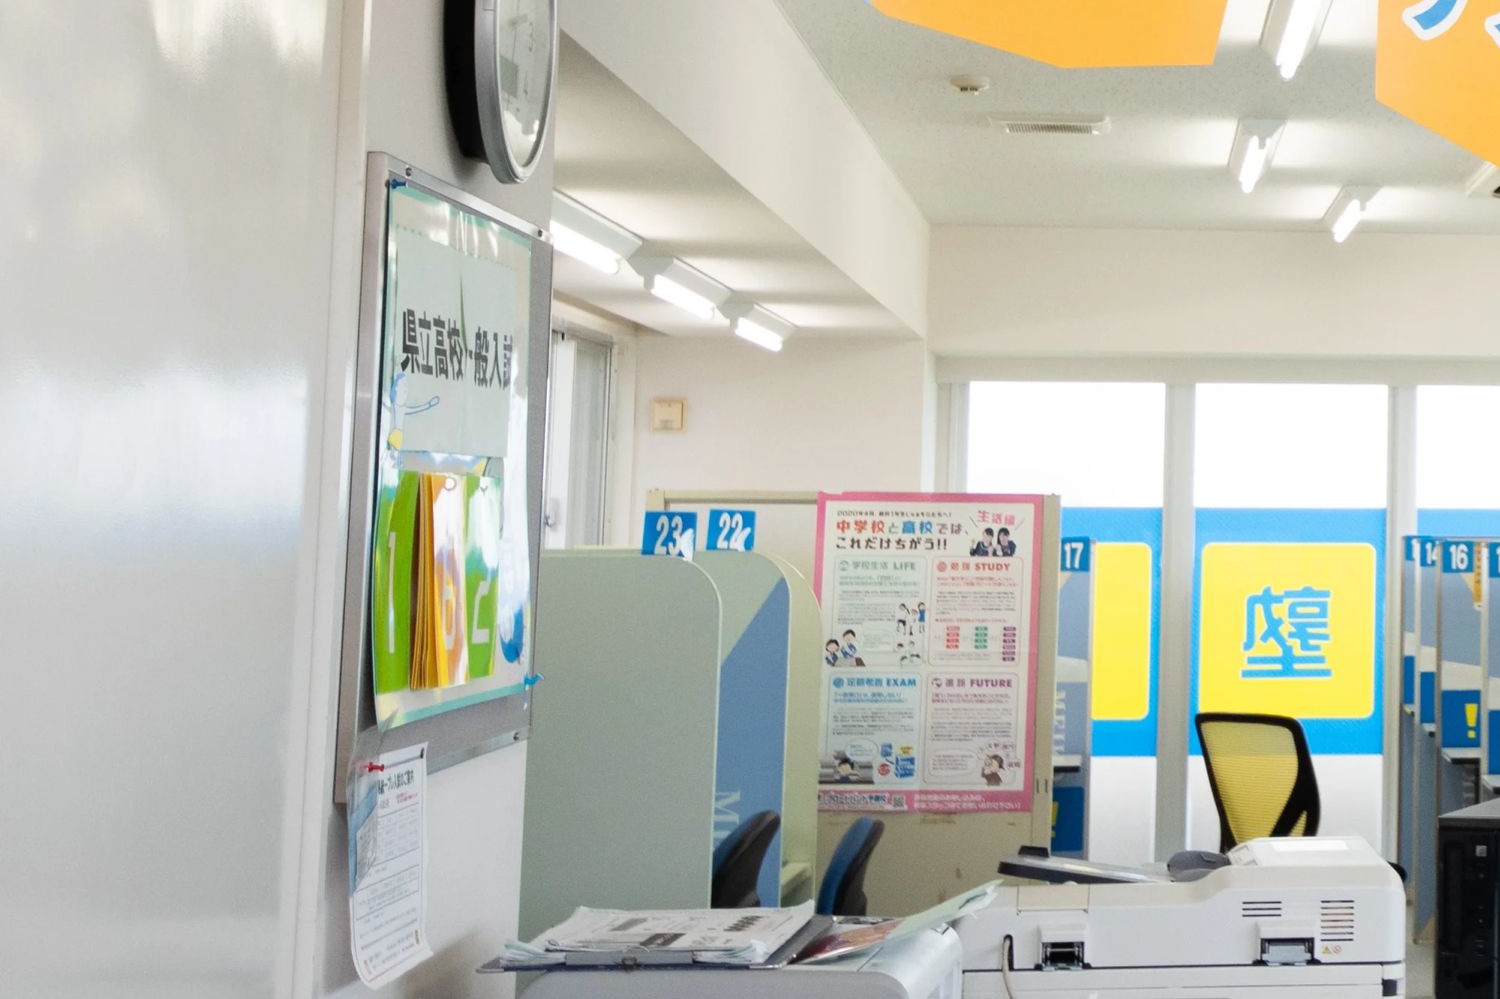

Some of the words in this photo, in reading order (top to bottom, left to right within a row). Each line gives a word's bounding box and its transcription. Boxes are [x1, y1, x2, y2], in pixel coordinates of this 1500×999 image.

[653, 514, 683, 555] 23
[716, 512, 744, 550] 22
[1064, 541, 1084, 569] 17
[1449, 543, 1469, 570] 16
[893, 561, 916, 571] LIFE
[975, 561, 1010, 571] STUDY
[886, 678, 917, 687] EXAM
[970, 678, 1013, 688] FUTURE
